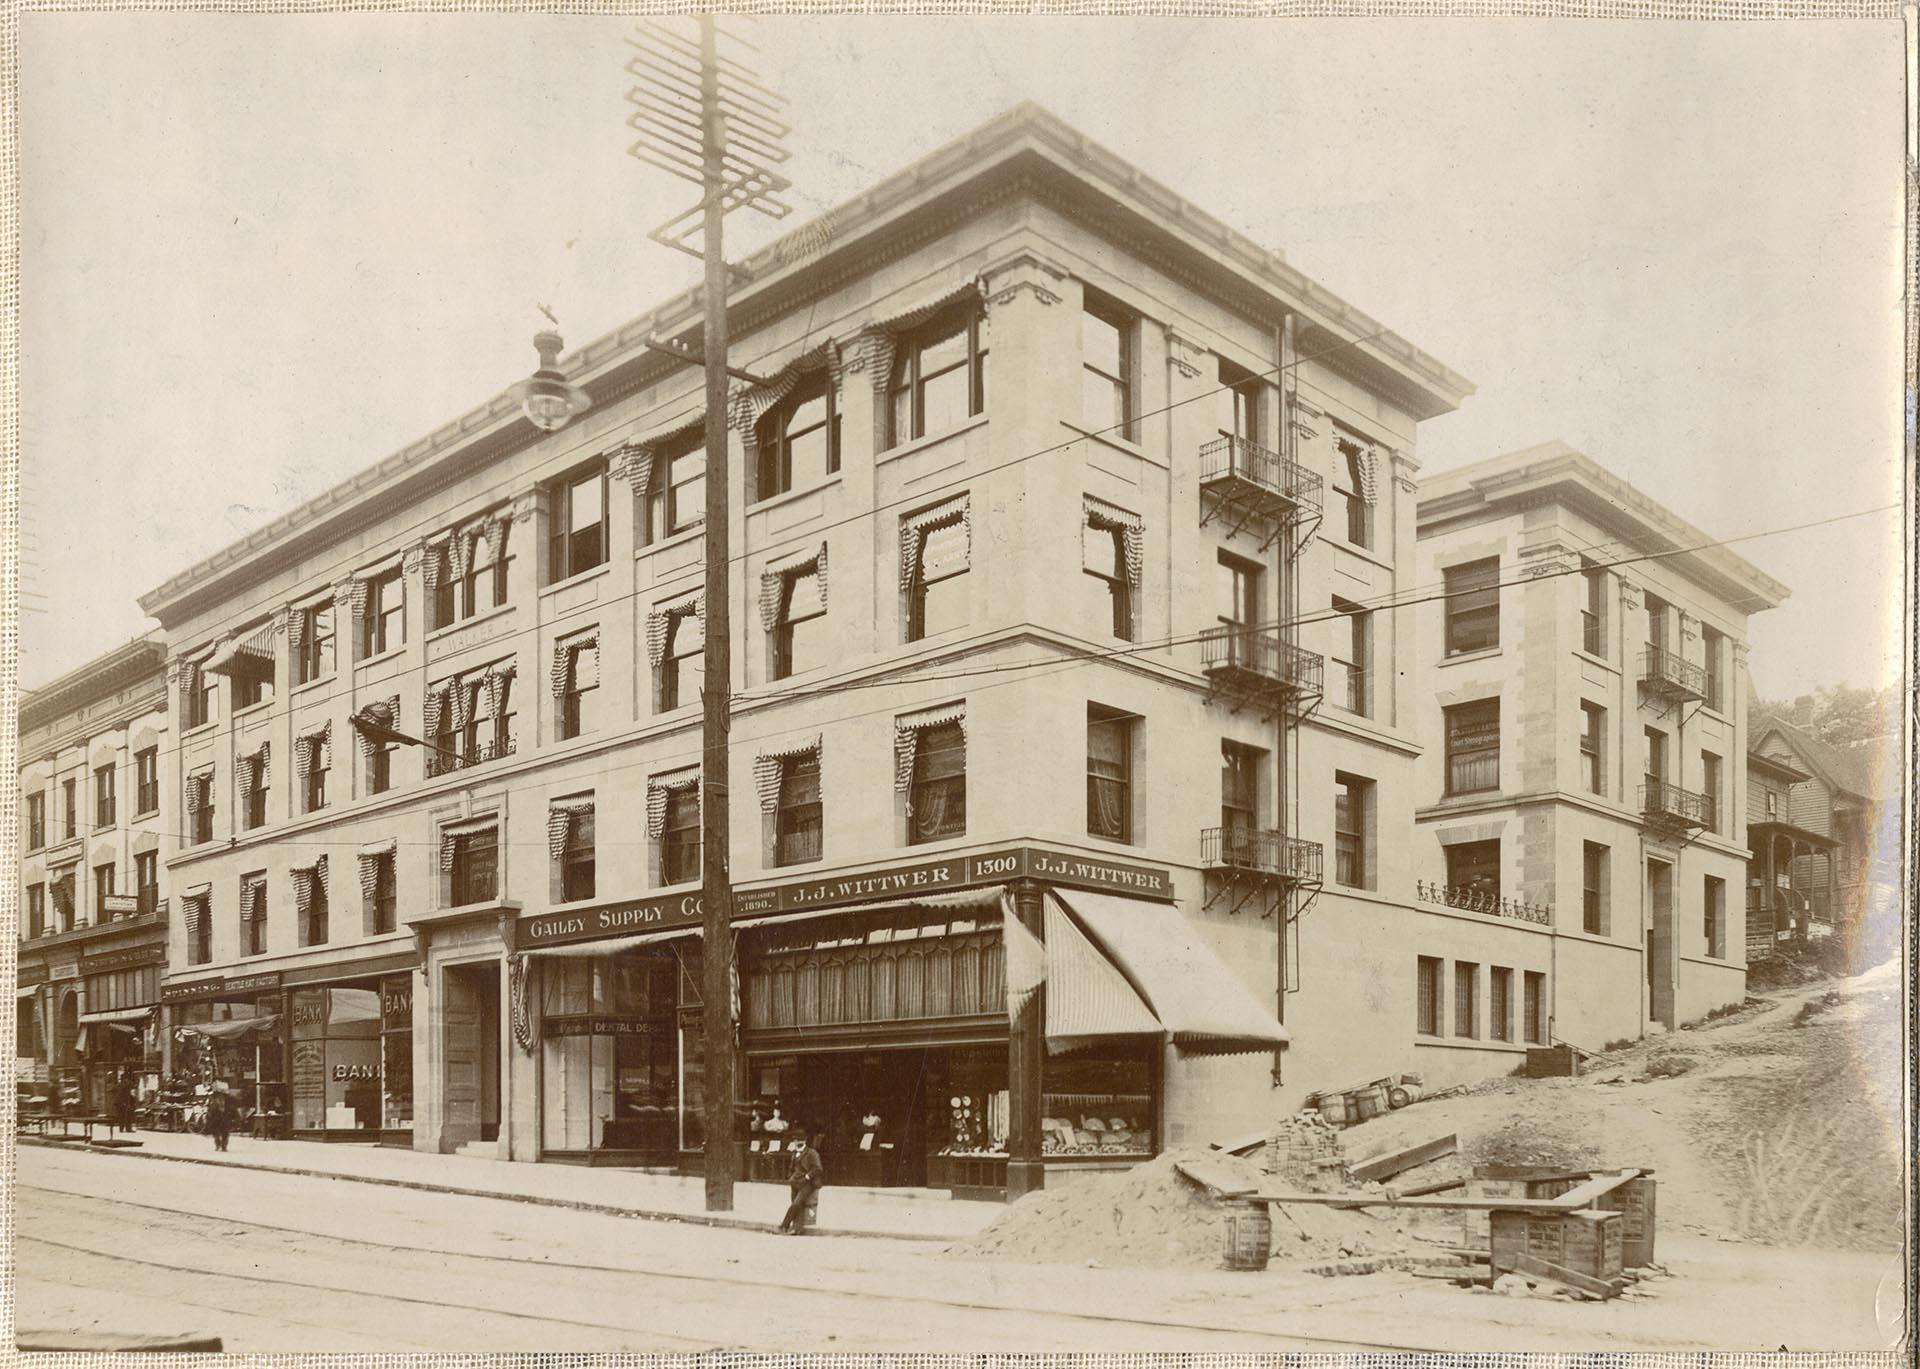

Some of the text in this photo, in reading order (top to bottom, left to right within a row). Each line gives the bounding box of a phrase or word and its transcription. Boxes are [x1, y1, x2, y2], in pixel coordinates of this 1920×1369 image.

[448, 623, 494, 651] WALKER
[976, 856, 1017, 876] 1300
[1076, 863, 1162, 889] WITTWER
[838, 867, 950, 897] WITTWER
[530, 918, 587, 938] GAILEY
[599, 906, 664, 928] SUPPLY
[294, 1003, 321, 1023] BANK
